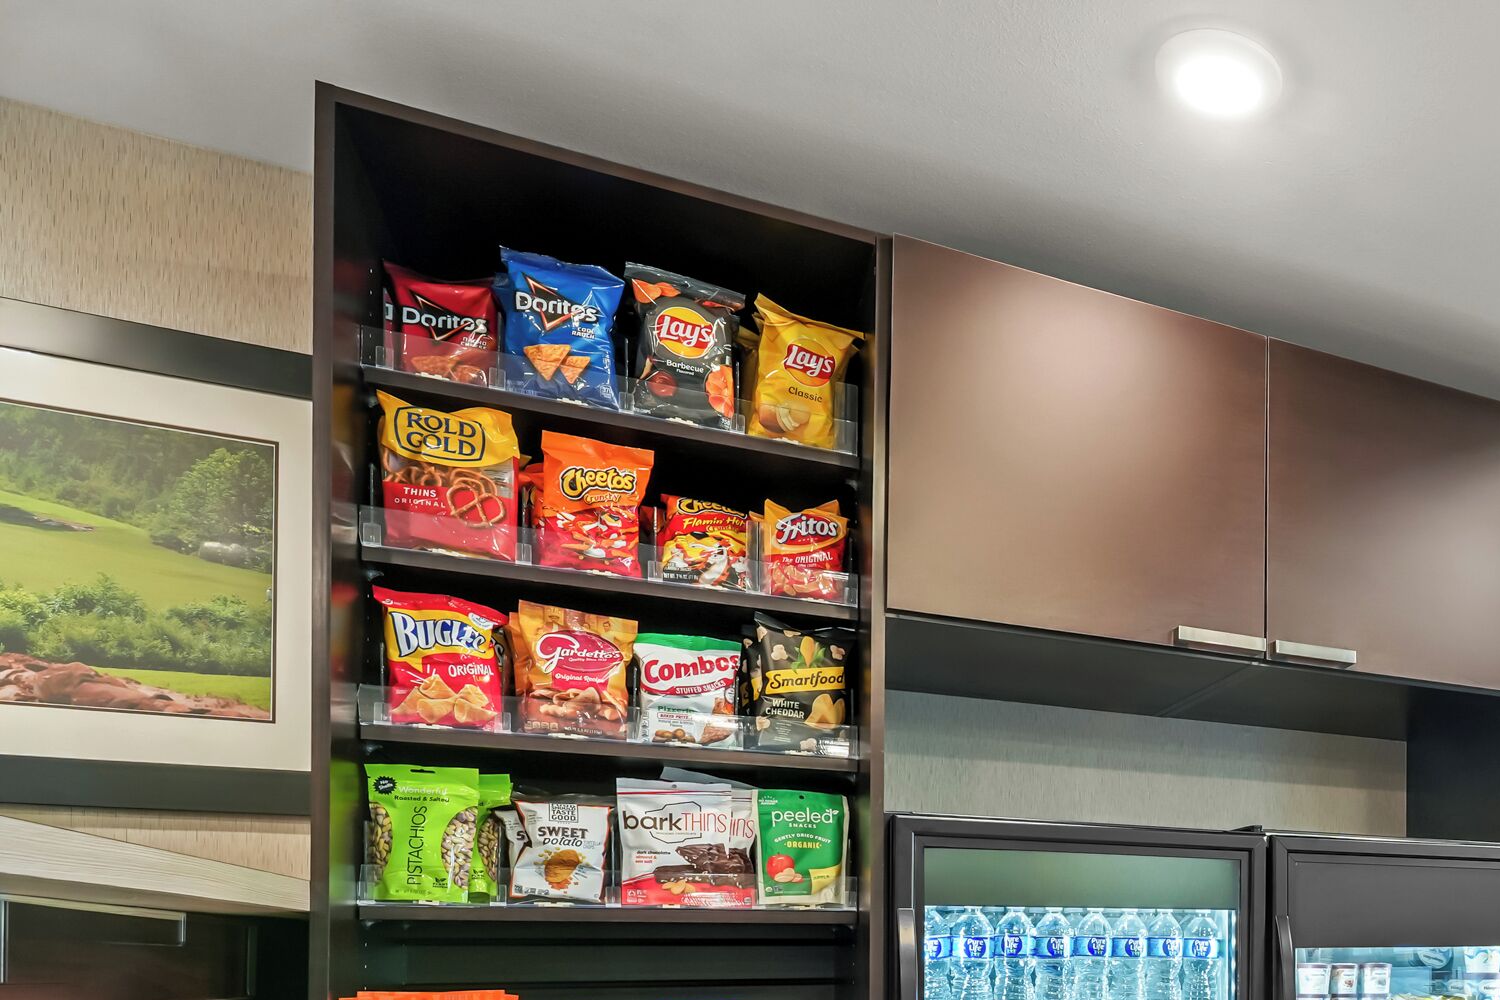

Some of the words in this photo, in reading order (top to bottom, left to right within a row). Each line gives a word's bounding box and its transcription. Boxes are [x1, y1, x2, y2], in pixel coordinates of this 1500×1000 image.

[515, 292, 600, 323] Doritos
[402, 306, 488, 334] Doritos
[659, 315, 714, 347] Lay's
[666, 359, 705, 374] Barbecue
[786, 345, 835, 377] Lay's
[788, 386, 823, 403] Classic
[407, 411, 476, 438] ROLD
[406, 431, 476, 457] GOLD
[403, 486, 438, 498] THINS
[561, 467, 637, 500] Cheetos
[394, 497, 446, 508] ORIGINAL
[776, 516, 839, 545] Fritos
[795, 552, 834, 564] ORIGINAL
[390, 611, 488, 658] BUGLES
[536, 634, 622, 674] Gardetto's
[448, 663, 495, 677] ORIGINAL
[555, 673, 584, 683] Original
[644, 654, 740, 684] Combos
[675, 685, 702, 695] STUFFED
[702, 679, 727, 693] SNACKS
[769, 671, 845, 690] Smartfood
[772, 699, 801, 710] WHITE
[765, 708, 805, 720] CHEDDAR
[398, 786, 448, 795] Wonderful
[622, 811, 727, 833] barkTHINS
[772, 808, 834, 827] peeled
[538, 827, 588, 839] SWEET
[774, 834, 795, 843] GENTLY
[814, 834, 832, 844] FRUIT
[407, 805, 428, 886] PISTACHIOS
[543, 837, 583, 848] potato
[786, 841, 821, 849] ORGANIC
